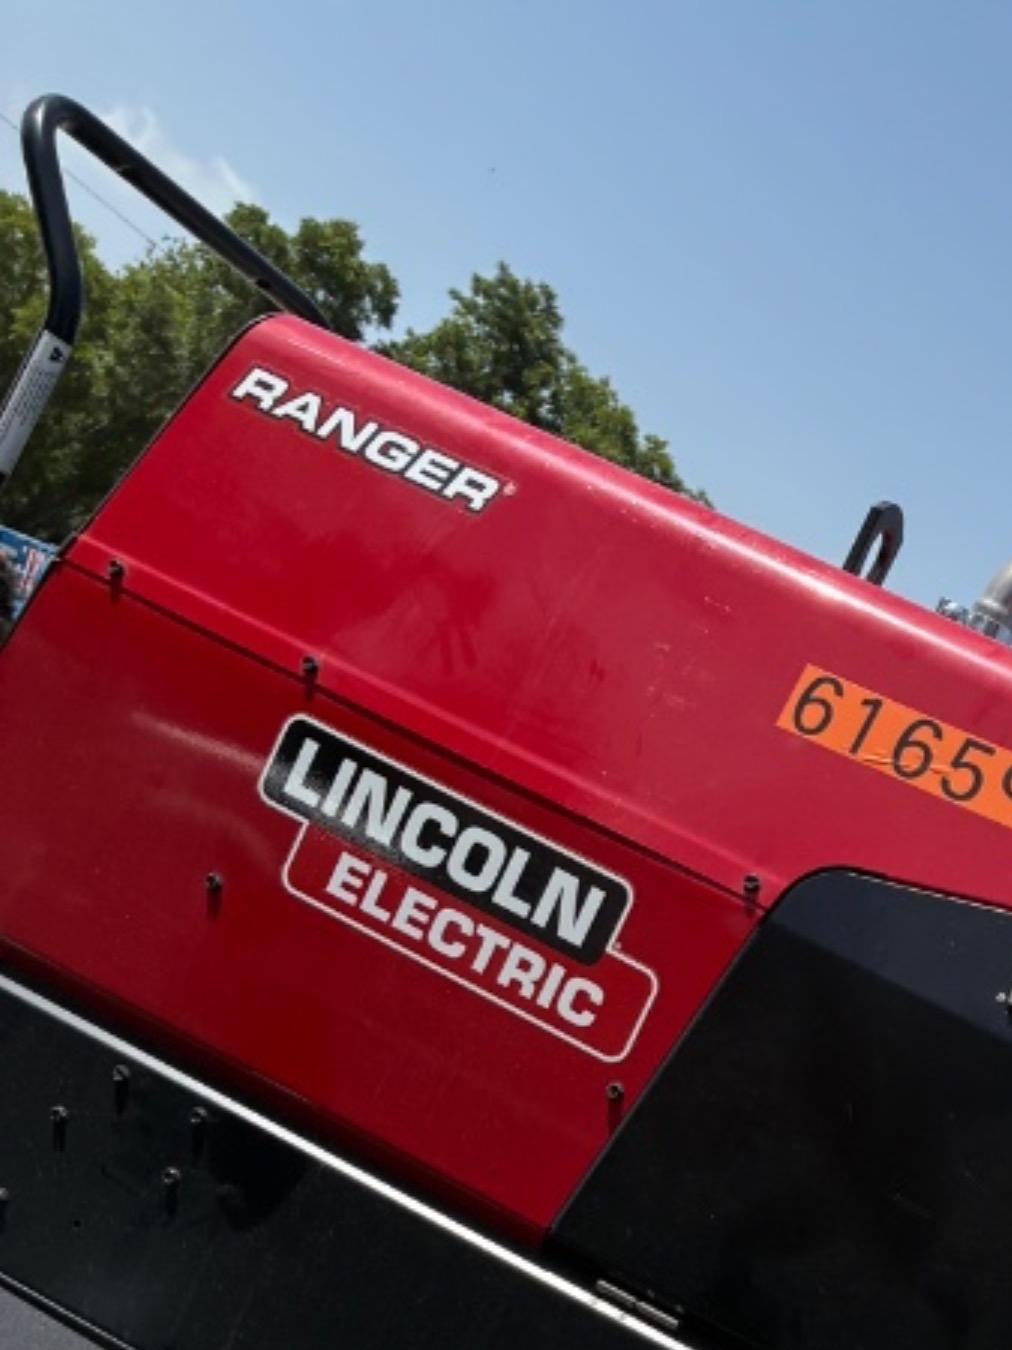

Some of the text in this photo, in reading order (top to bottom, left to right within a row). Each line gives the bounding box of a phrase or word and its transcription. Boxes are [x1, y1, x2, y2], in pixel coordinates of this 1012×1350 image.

[232, 367, 500, 512] RANGER
[282, 737, 607, 950] LINCOLN
[325, 850, 604, 1028] ELECTRIC
